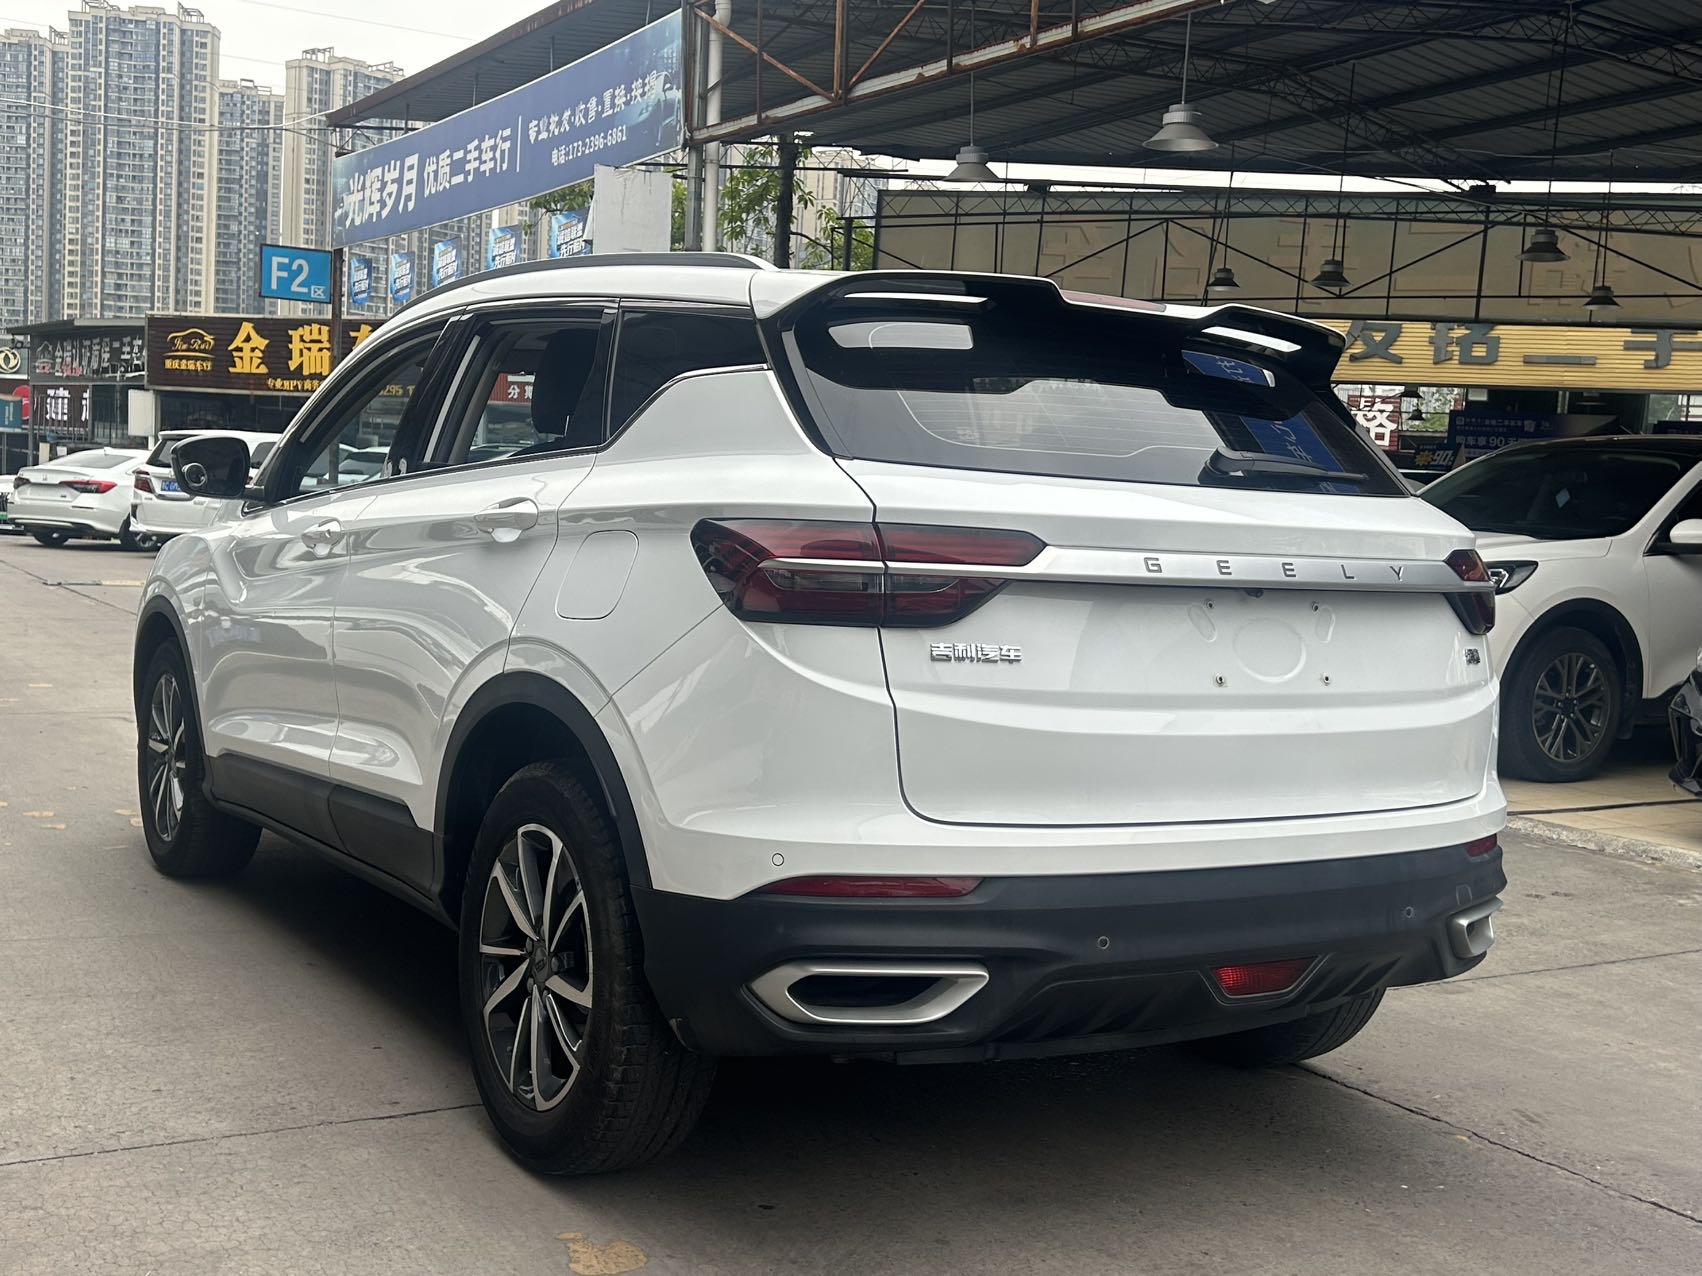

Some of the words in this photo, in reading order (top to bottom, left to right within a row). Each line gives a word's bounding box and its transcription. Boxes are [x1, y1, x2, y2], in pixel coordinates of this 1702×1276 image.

[345, 153, 419, 229] 光辉岁月
[424, 127, 511, 198] 优质二手车行
[267, 377, 323, 392] 专业MPV商务
[1143, 557, 1404, 581] GEELY
[930, 642, 1022, 664] 吉利汽车
